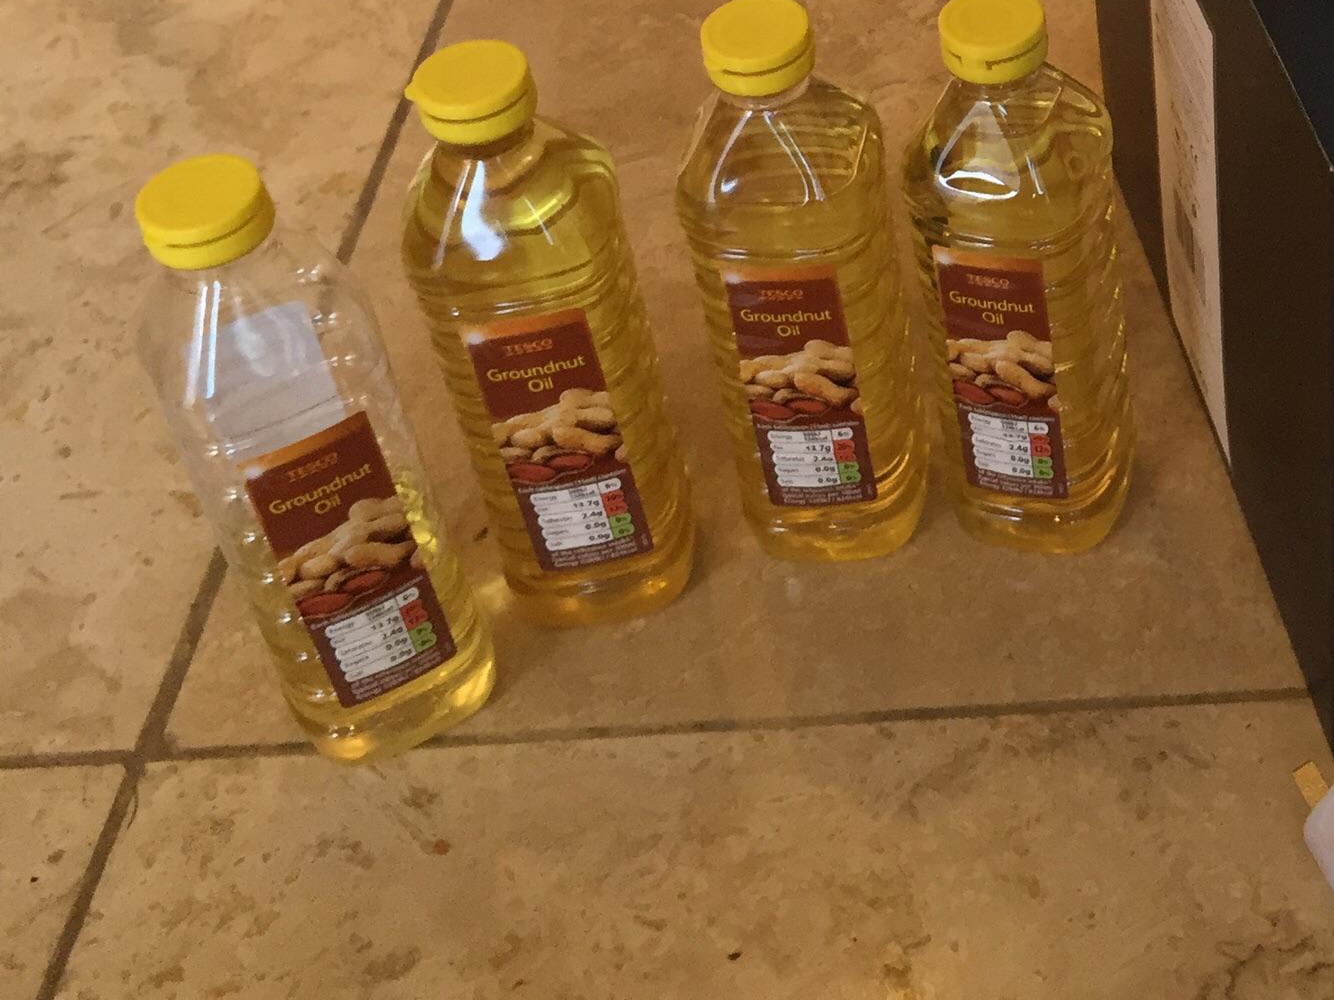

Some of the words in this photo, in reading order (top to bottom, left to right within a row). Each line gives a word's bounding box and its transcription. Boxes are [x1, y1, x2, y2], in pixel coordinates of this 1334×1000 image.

[949, 291, 1036, 314] Groundnut
[740, 309, 832, 323] Groundnut
[982, 310, 1004, 325] Oil
[776, 323, 800, 337] Oil
[486, 354, 586, 383] Groundnut
[527, 378, 554, 393] Oil
[269, 462, 372, 515] Groundnut
[314, 497, 341, 516] Oil
